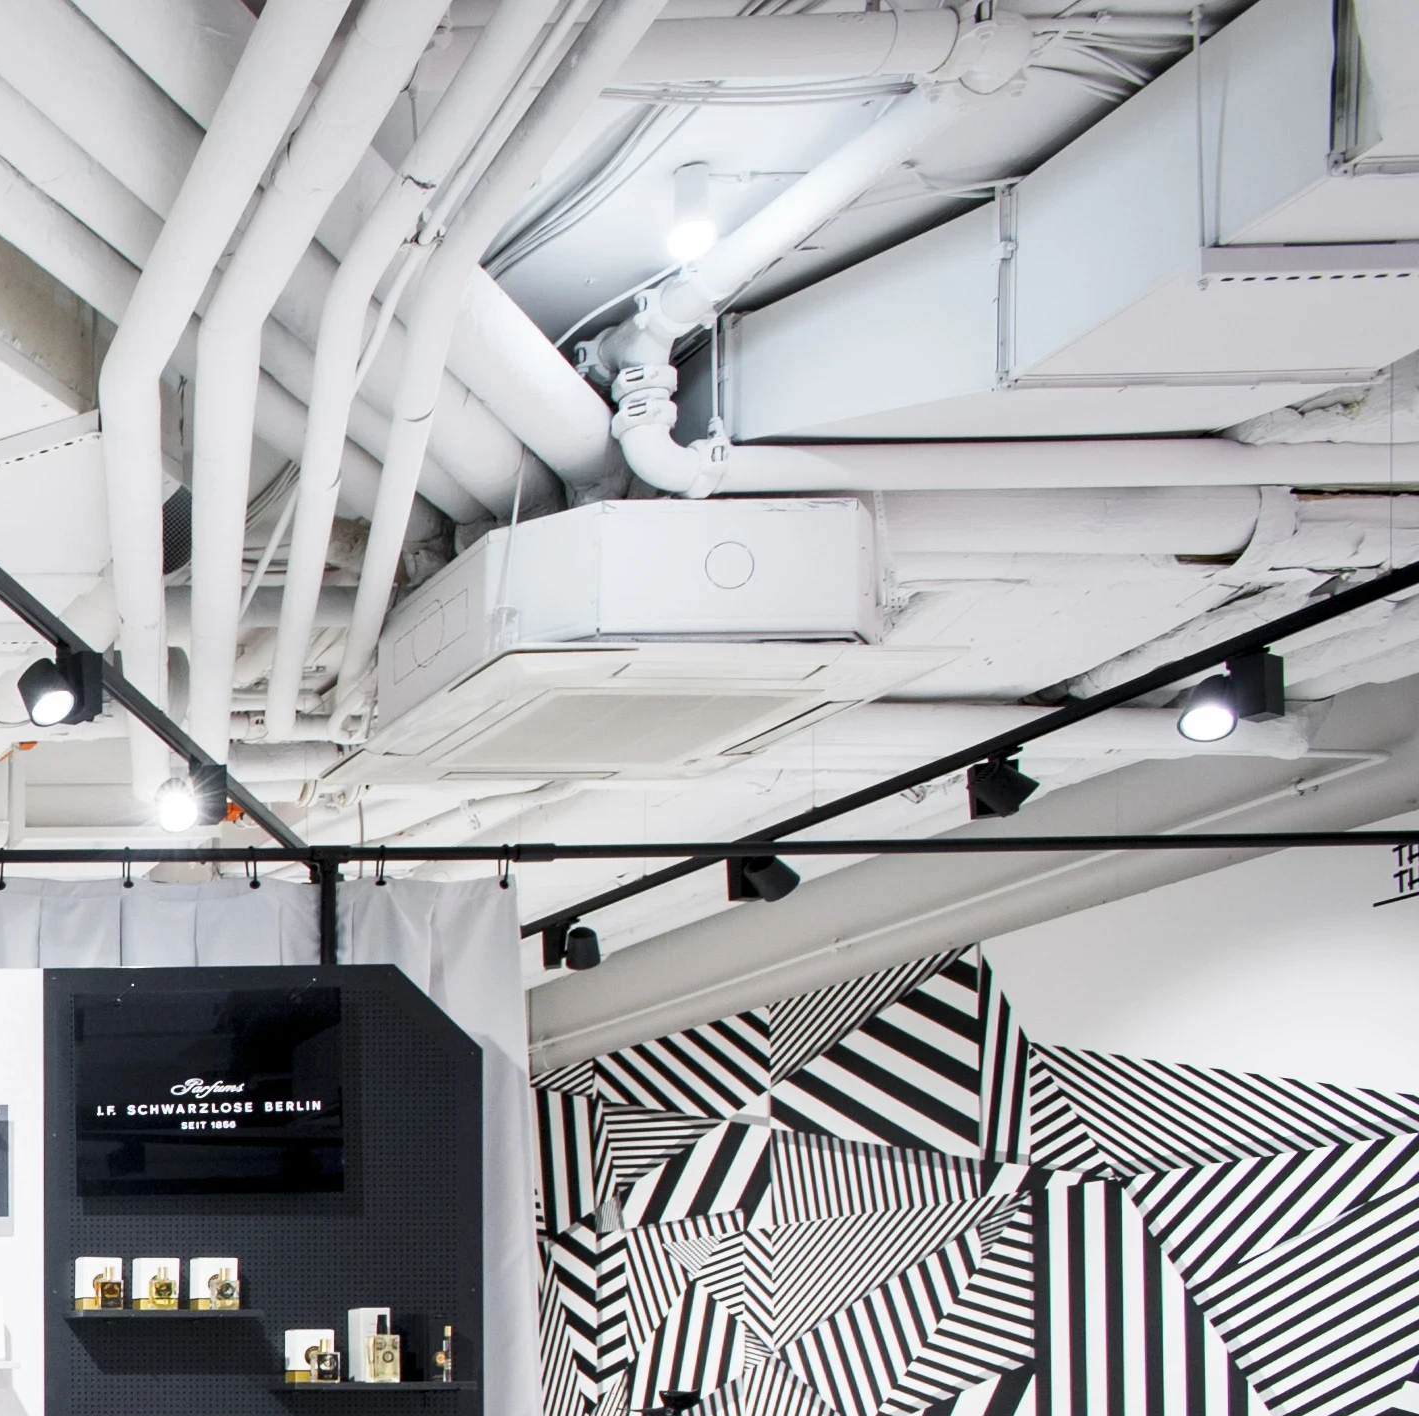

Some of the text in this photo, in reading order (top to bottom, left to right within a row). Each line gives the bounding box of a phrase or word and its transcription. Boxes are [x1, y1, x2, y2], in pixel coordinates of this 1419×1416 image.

[170, 1078, 245, 1098] Parfums
[127, 1101, 253, 1116] SCHWARZLOSE
[264, 1100, 322, 1112] BERLIN
[181, 1121, 207, 1130] SEIT
